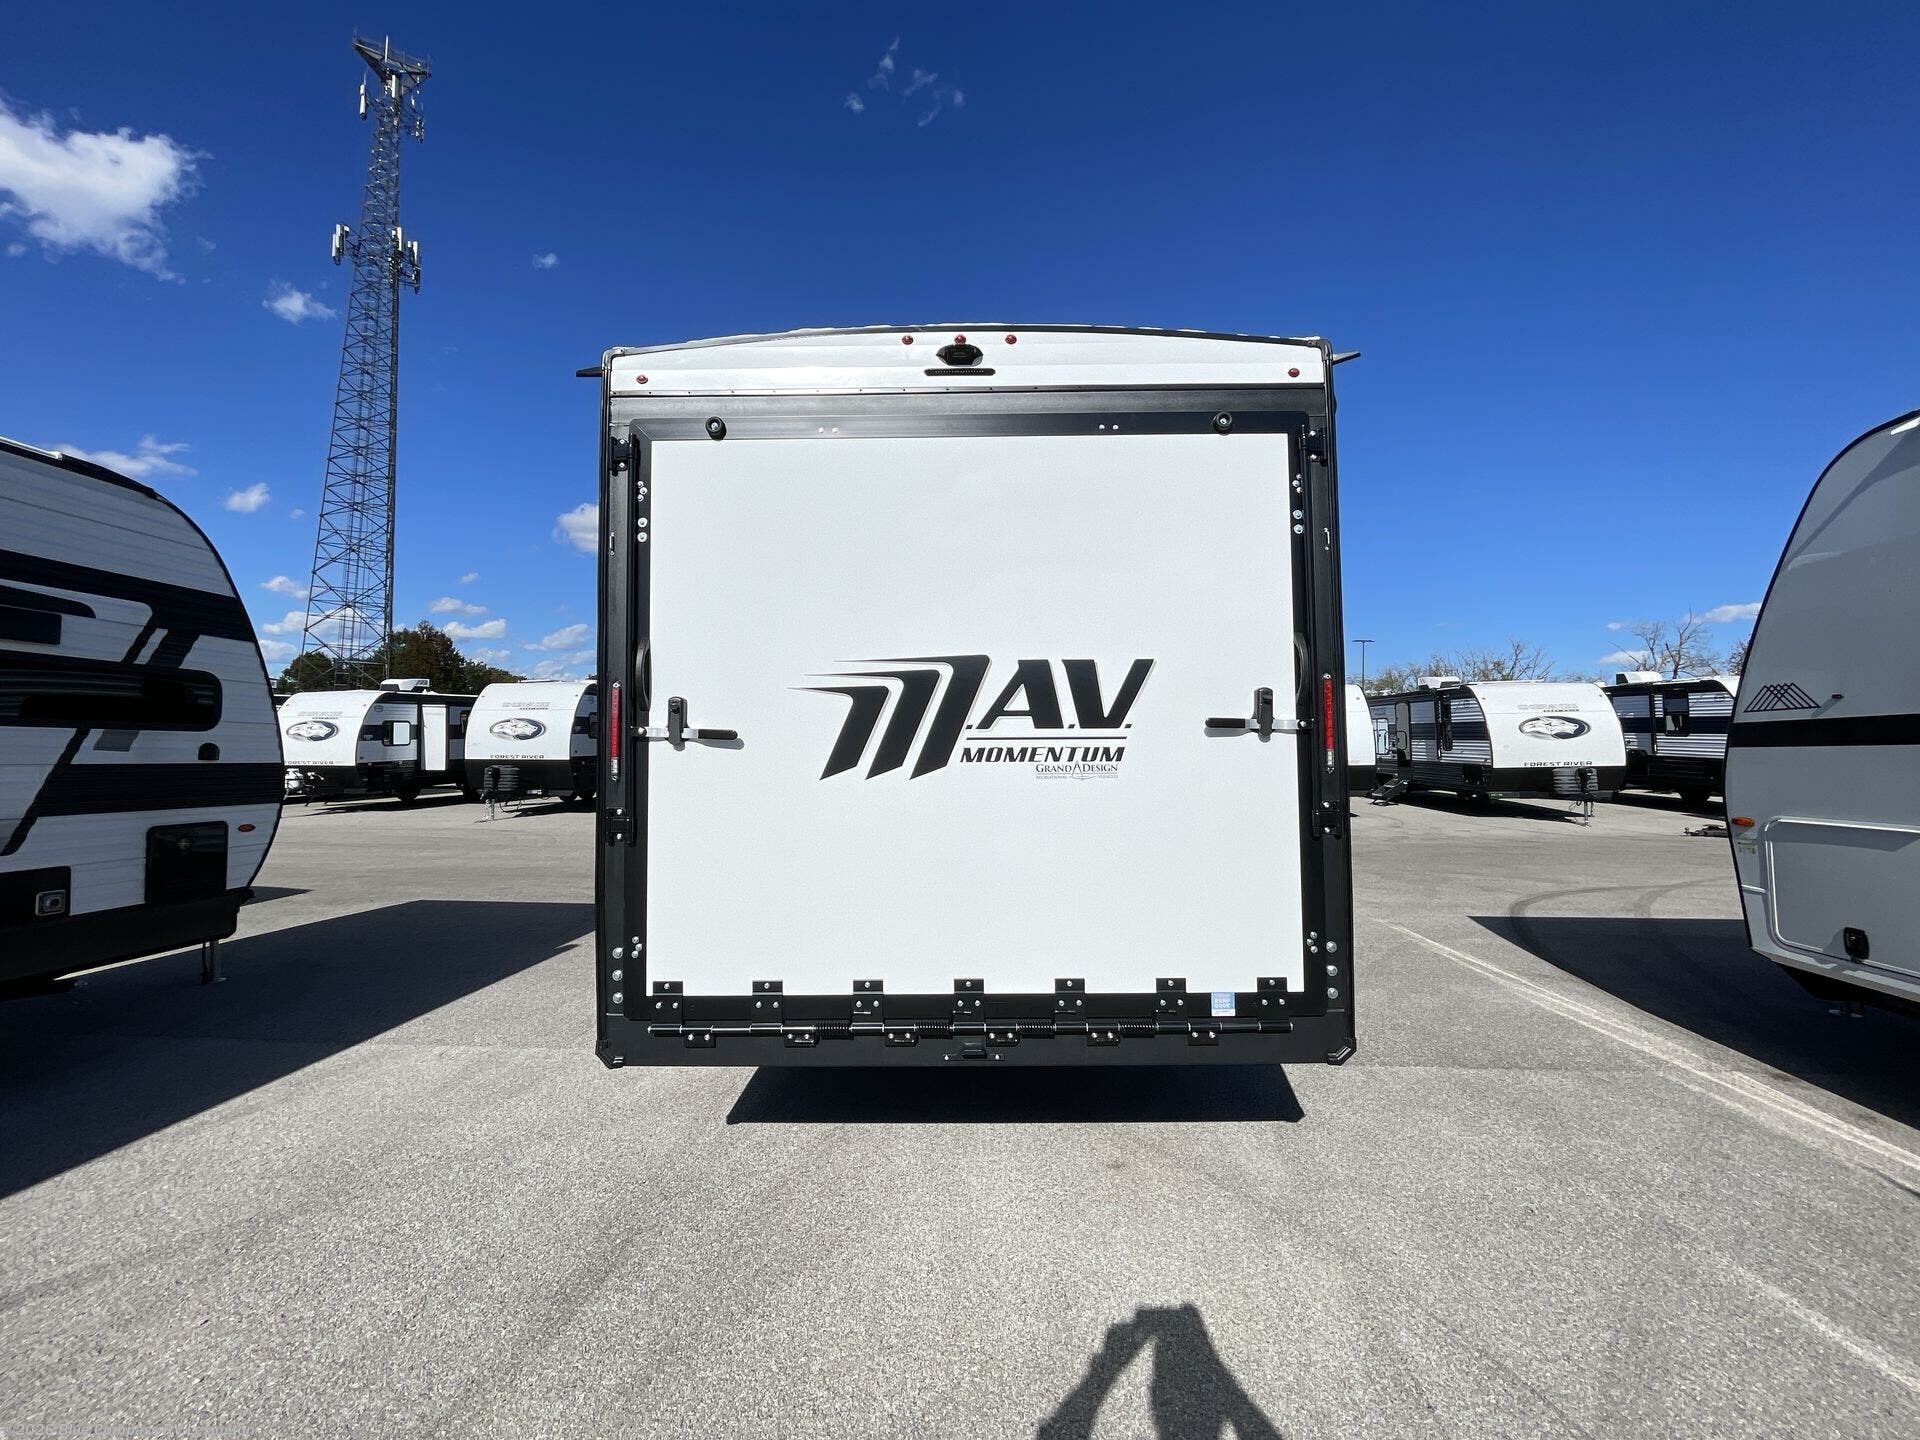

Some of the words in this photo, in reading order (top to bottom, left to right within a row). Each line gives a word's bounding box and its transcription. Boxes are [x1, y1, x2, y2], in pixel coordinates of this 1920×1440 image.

[960, 747, 1126, 763] MOMENTUM
[1036, 763, 1072, 772] GRAND
[1082, 763, 1118, 772] DESIGN
